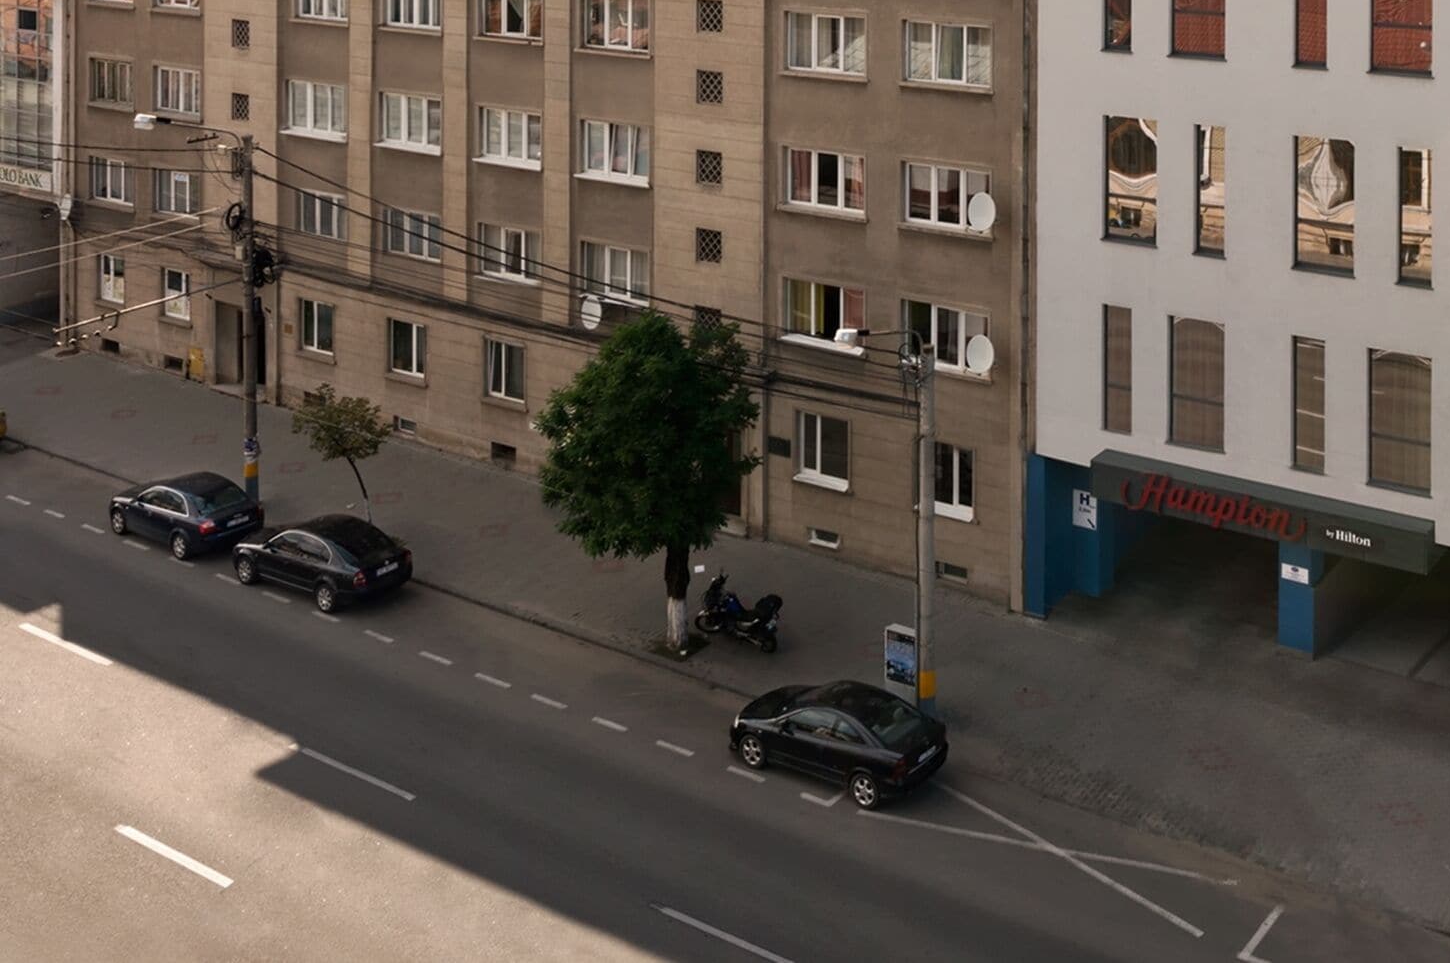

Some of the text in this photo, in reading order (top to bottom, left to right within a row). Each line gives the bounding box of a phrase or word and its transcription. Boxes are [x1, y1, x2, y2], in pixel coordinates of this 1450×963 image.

[18, 170, 43, 188] BANK
[1121, 470, 1307, 541] Hampton
[1325, 529, 1371, 547] by Hilton
